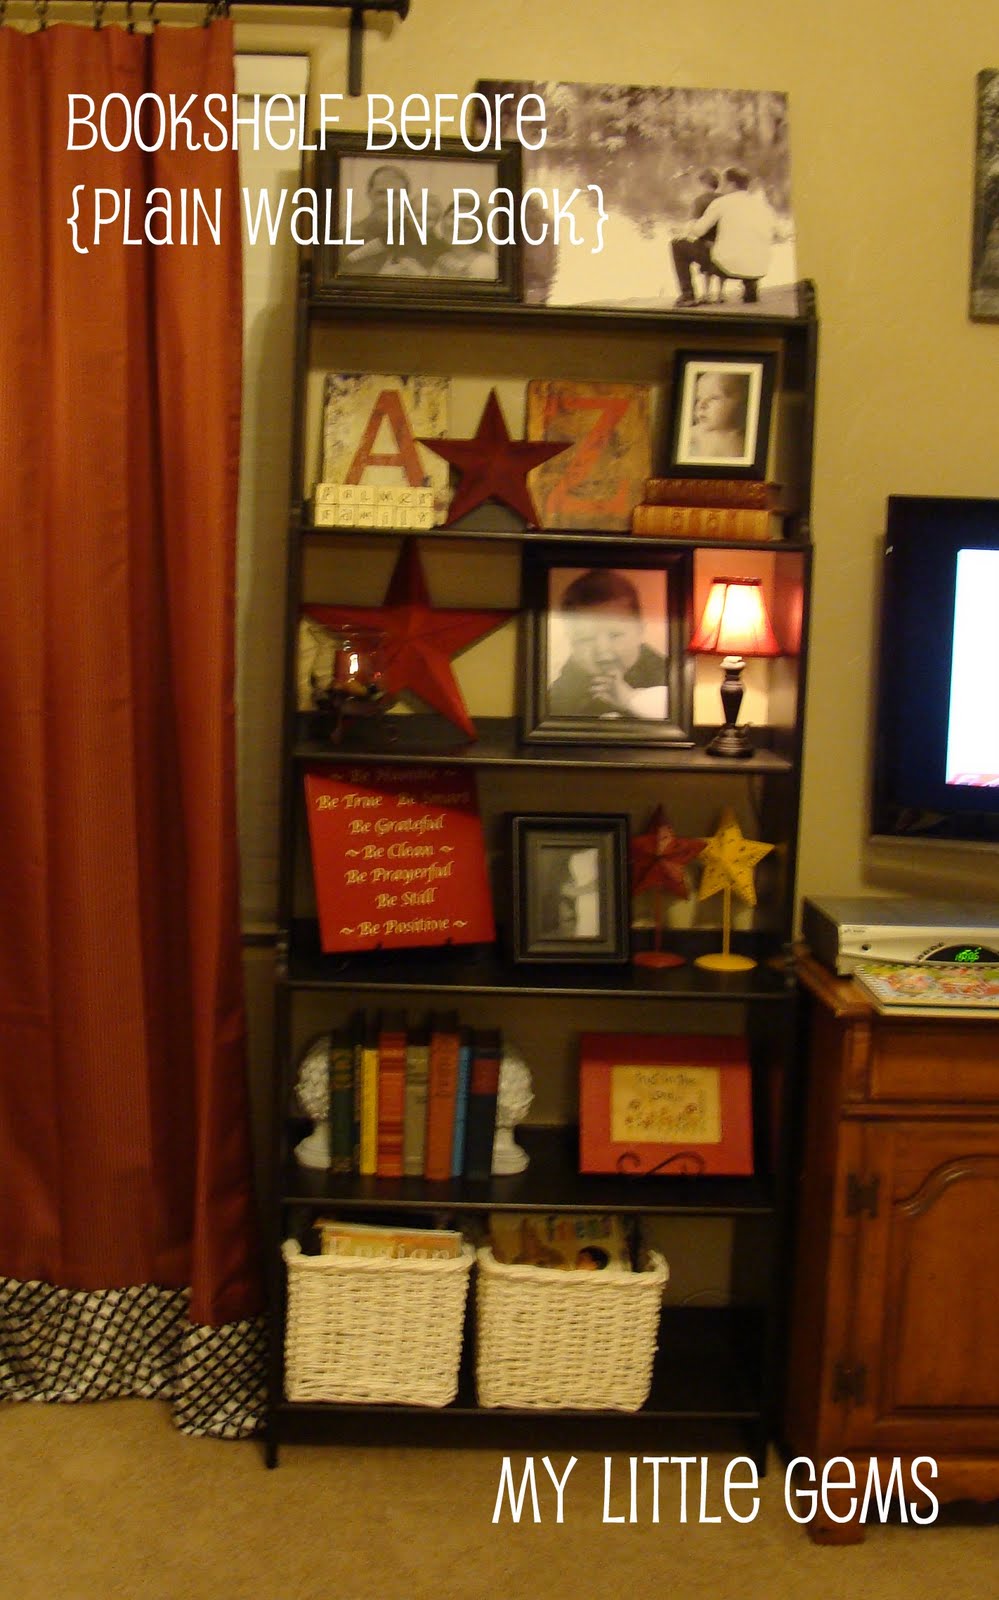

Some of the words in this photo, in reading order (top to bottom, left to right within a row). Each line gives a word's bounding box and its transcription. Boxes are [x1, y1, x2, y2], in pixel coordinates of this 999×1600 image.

[344, 389, 427, 488] A
[545, 396, 630, 514] Z
[316, 795, 339, 811] Be
[341, 793, 383, 810] True
[348, 819, 371, 835] Be
[374, 814, 447, 837] Grateful
[362, 844, 385, 861] Be
[387, 841, 434, 860] Clean
[344, 869, 368, 885] Be
[370, 861, 455, 886] Prayerful
[375, 893, 398, 910] Be
[400, 887, 438, 908] Still
[358, 921, 381, 937] Be
[382, 916, 450, 936] Positive
